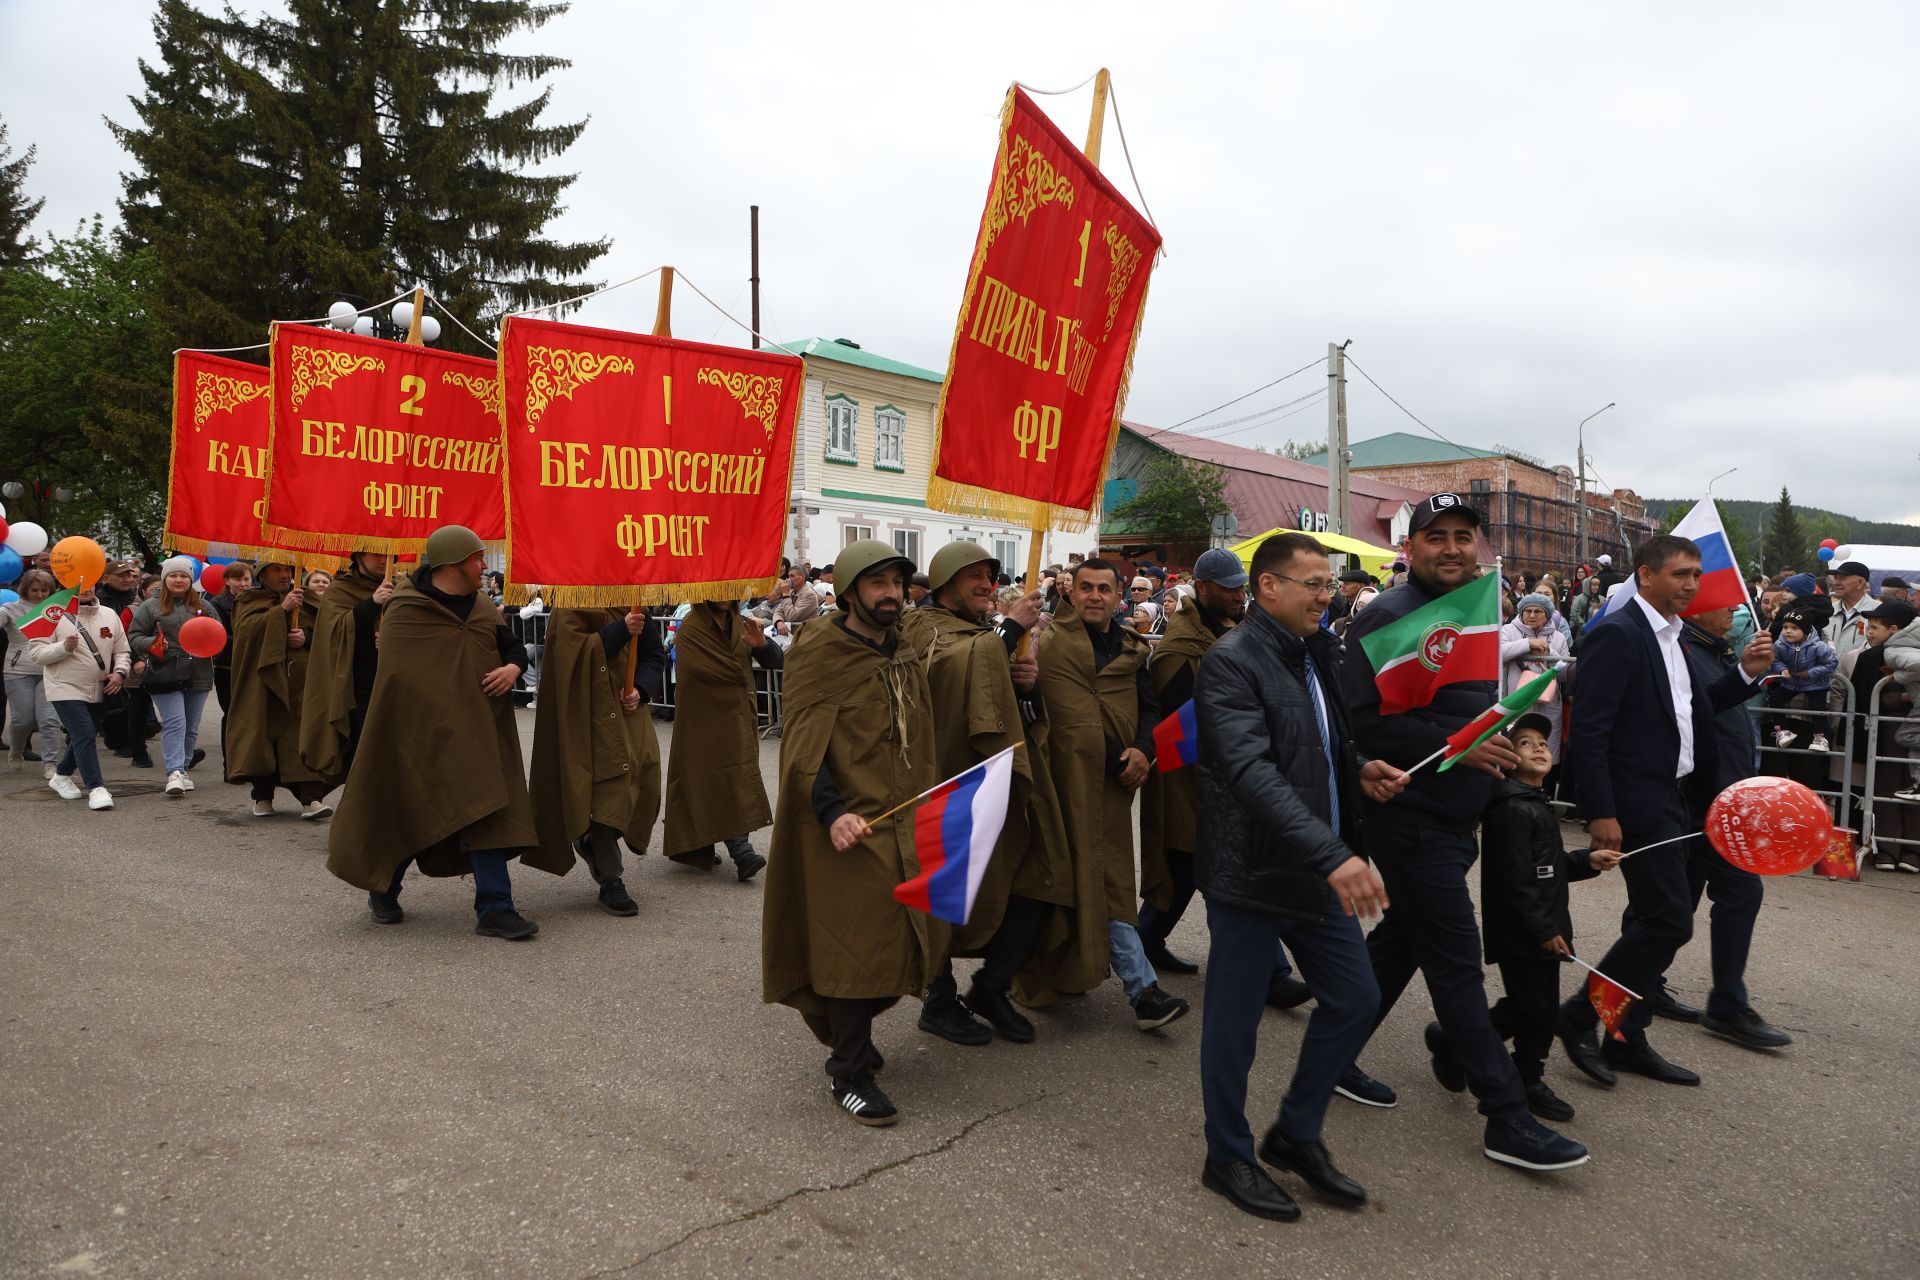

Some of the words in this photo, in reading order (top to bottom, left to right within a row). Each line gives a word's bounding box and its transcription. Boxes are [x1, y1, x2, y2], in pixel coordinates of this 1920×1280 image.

[1073, 220, 1092, 288] 1
[400, 374, 426, 416] 2
[363, 481, 444, 519] ФРОНТ
[616, 514, 710, 558] ФРОНТ
[1732, 816, 1741, 826] С
